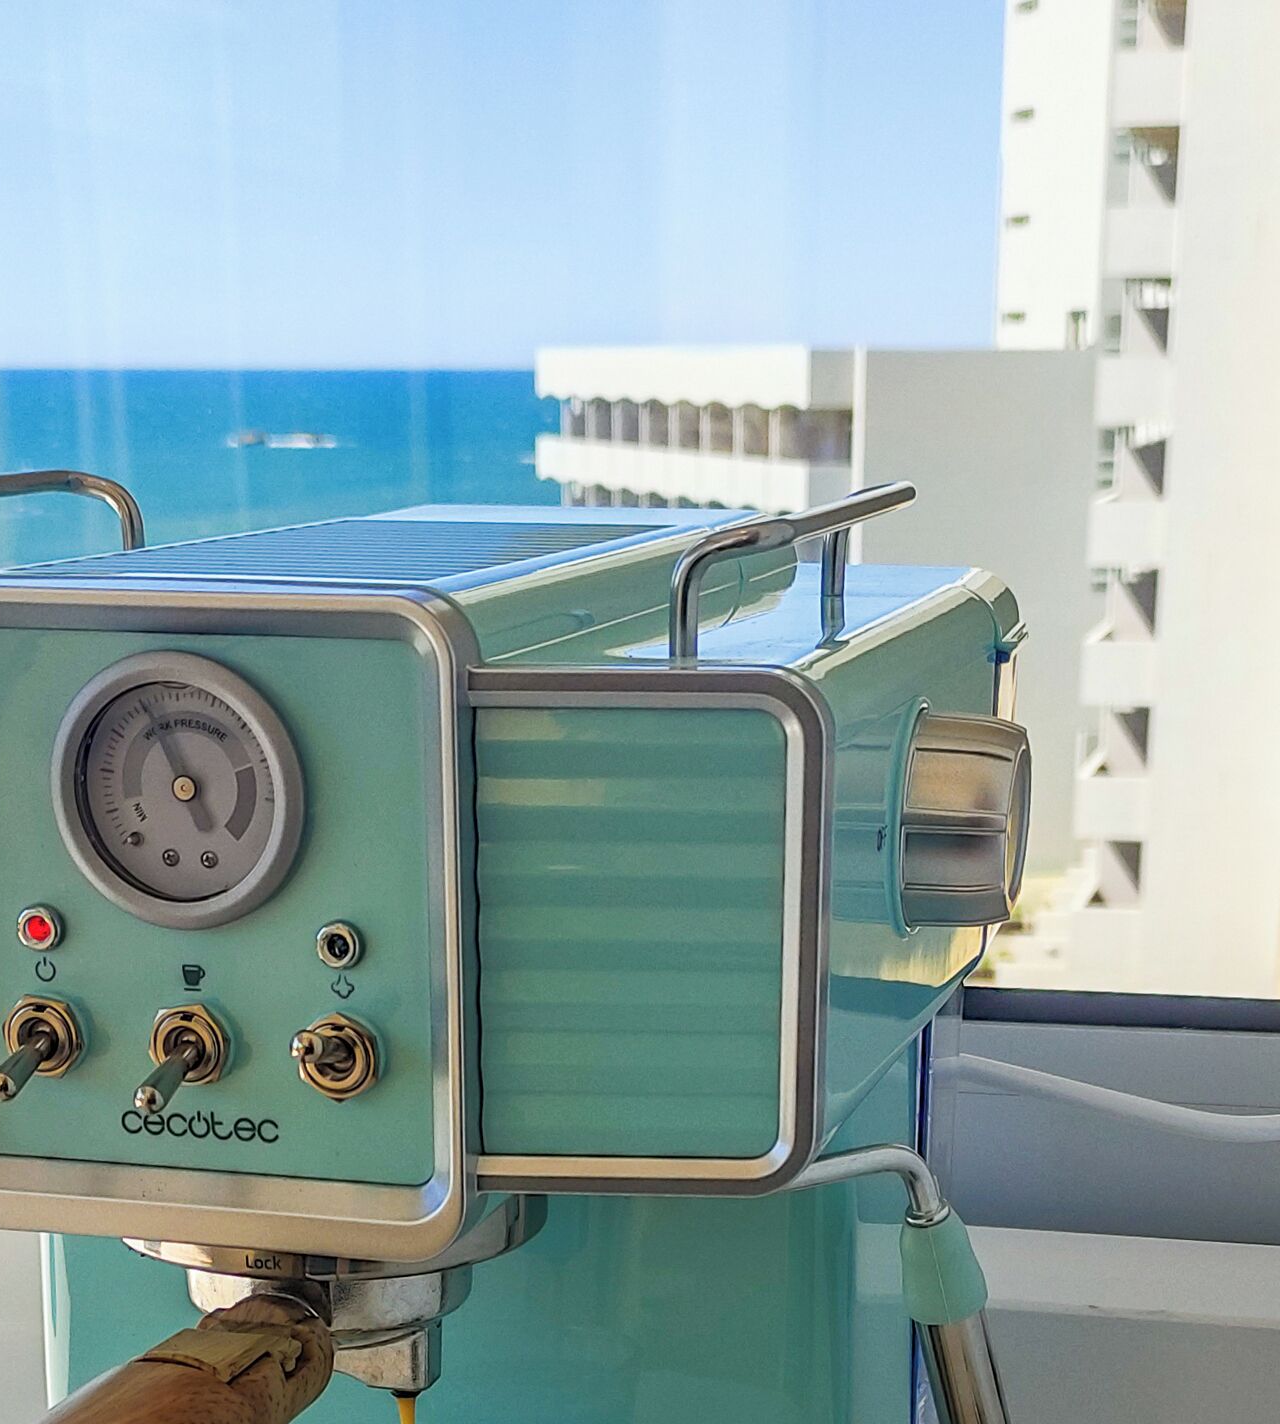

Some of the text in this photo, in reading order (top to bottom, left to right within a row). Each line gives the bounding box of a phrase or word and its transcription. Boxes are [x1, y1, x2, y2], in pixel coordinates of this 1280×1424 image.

[173, 719, 229, 742] PRESSURE
[121, 1110, 280, 1144] cecotec
[245, 1254, 282, 1271] Lock
